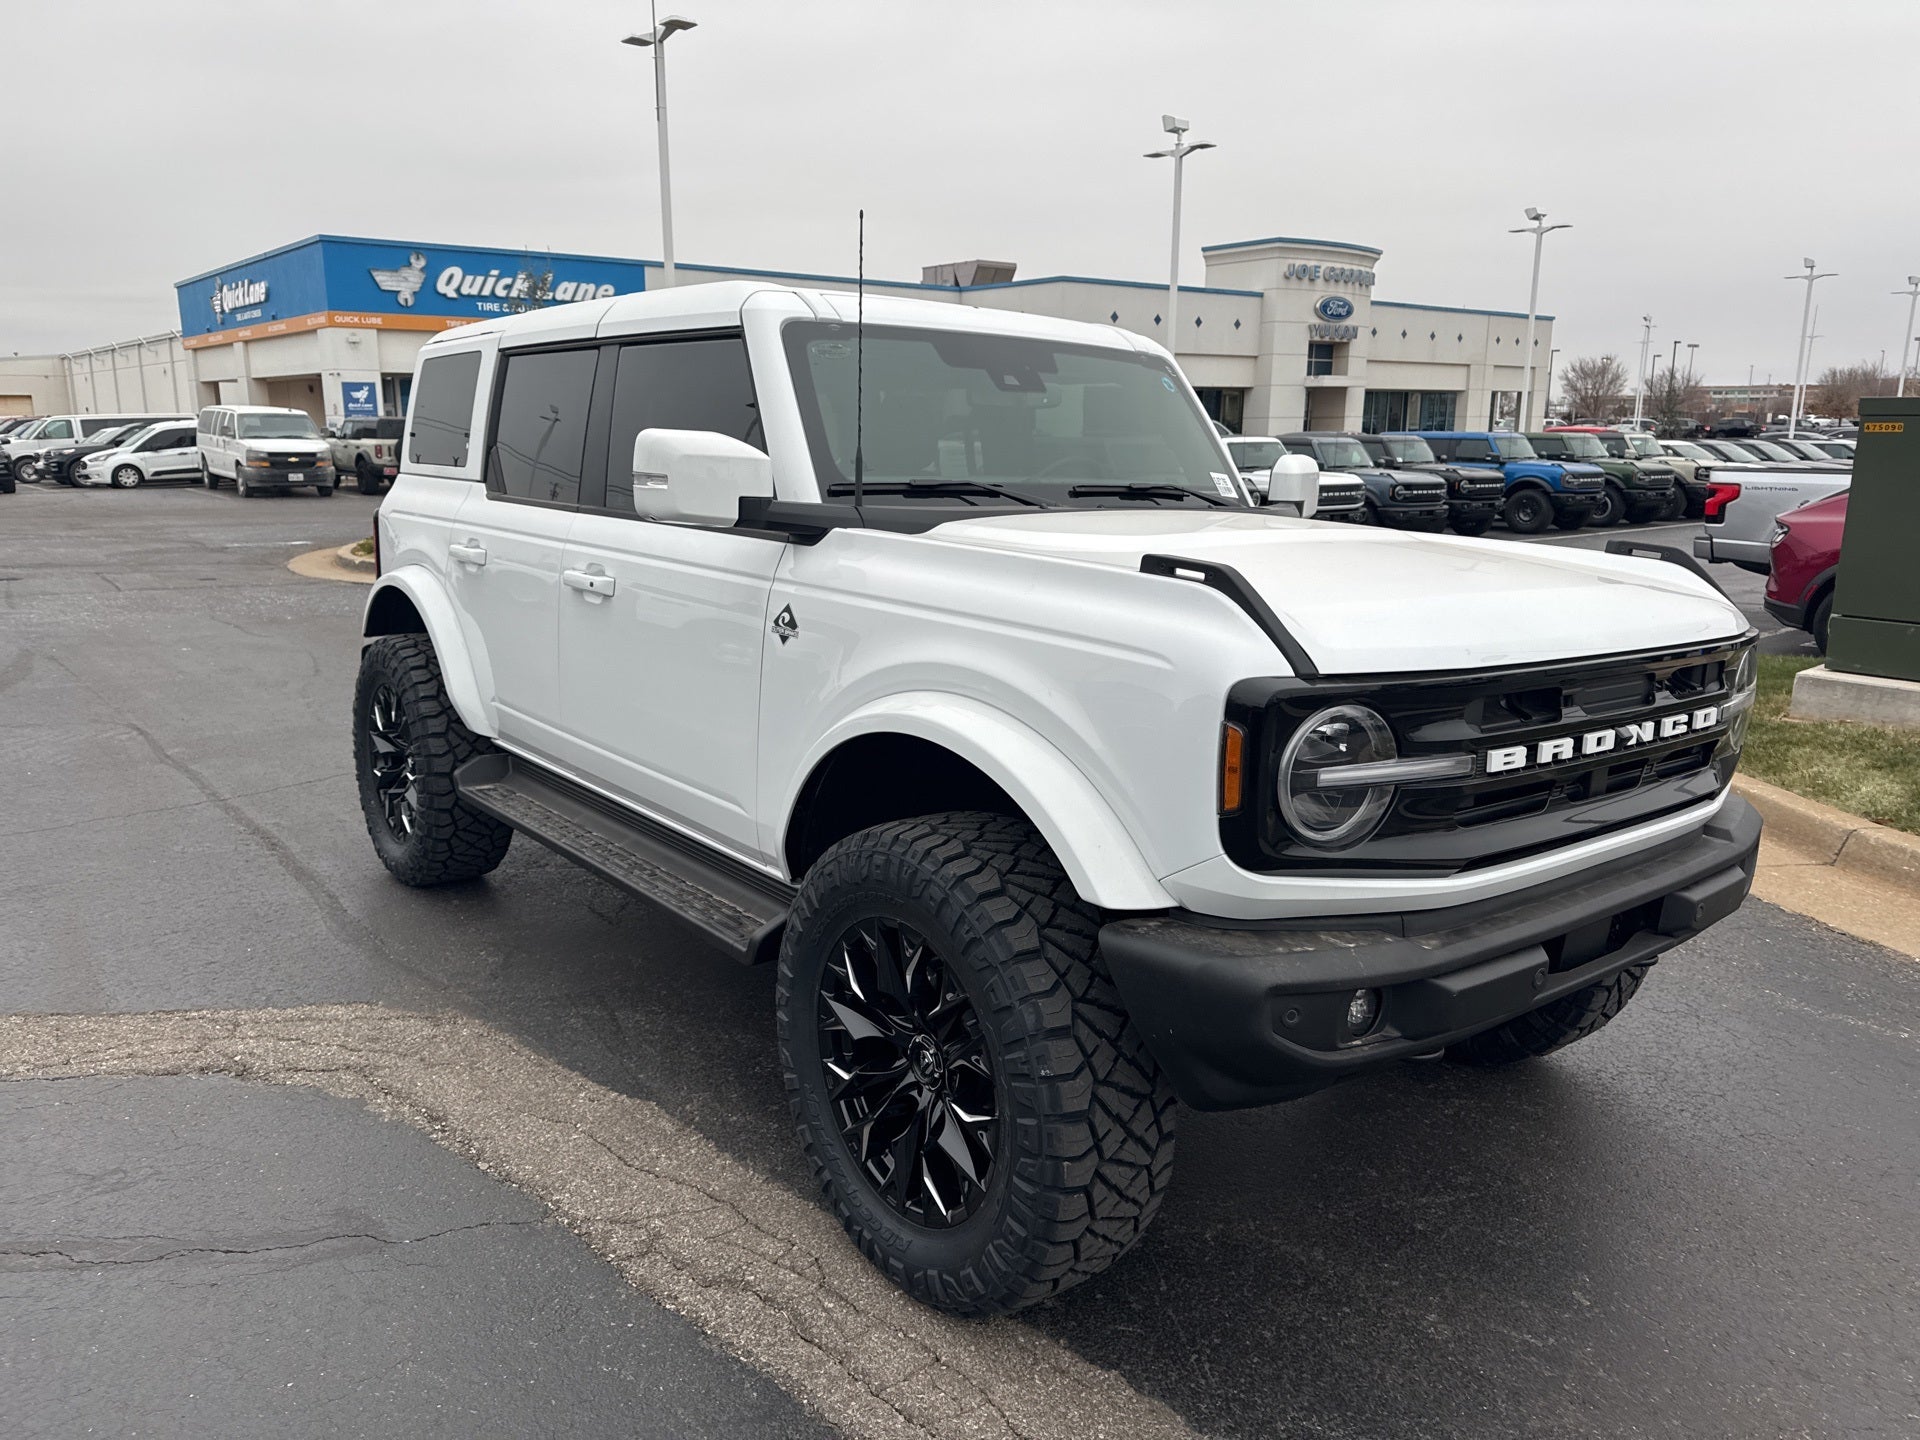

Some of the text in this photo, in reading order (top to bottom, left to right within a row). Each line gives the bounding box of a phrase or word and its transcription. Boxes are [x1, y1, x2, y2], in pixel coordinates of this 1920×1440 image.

[1285, 264, 1321, 280] JOE
[436, 266, 529, 298] Quick
[222, 279, 267, 313] Quick Lane
[476, 302, 500, 312] TIRE
[1326, 300, 1349, 315] Ford
[334, 315, 360, 324] QUICK
[361, 316, 383, 325] LUBE
[1309, 323, 1358, 340] YUKON
[1487, 707, 1718, 773] BRONCO
